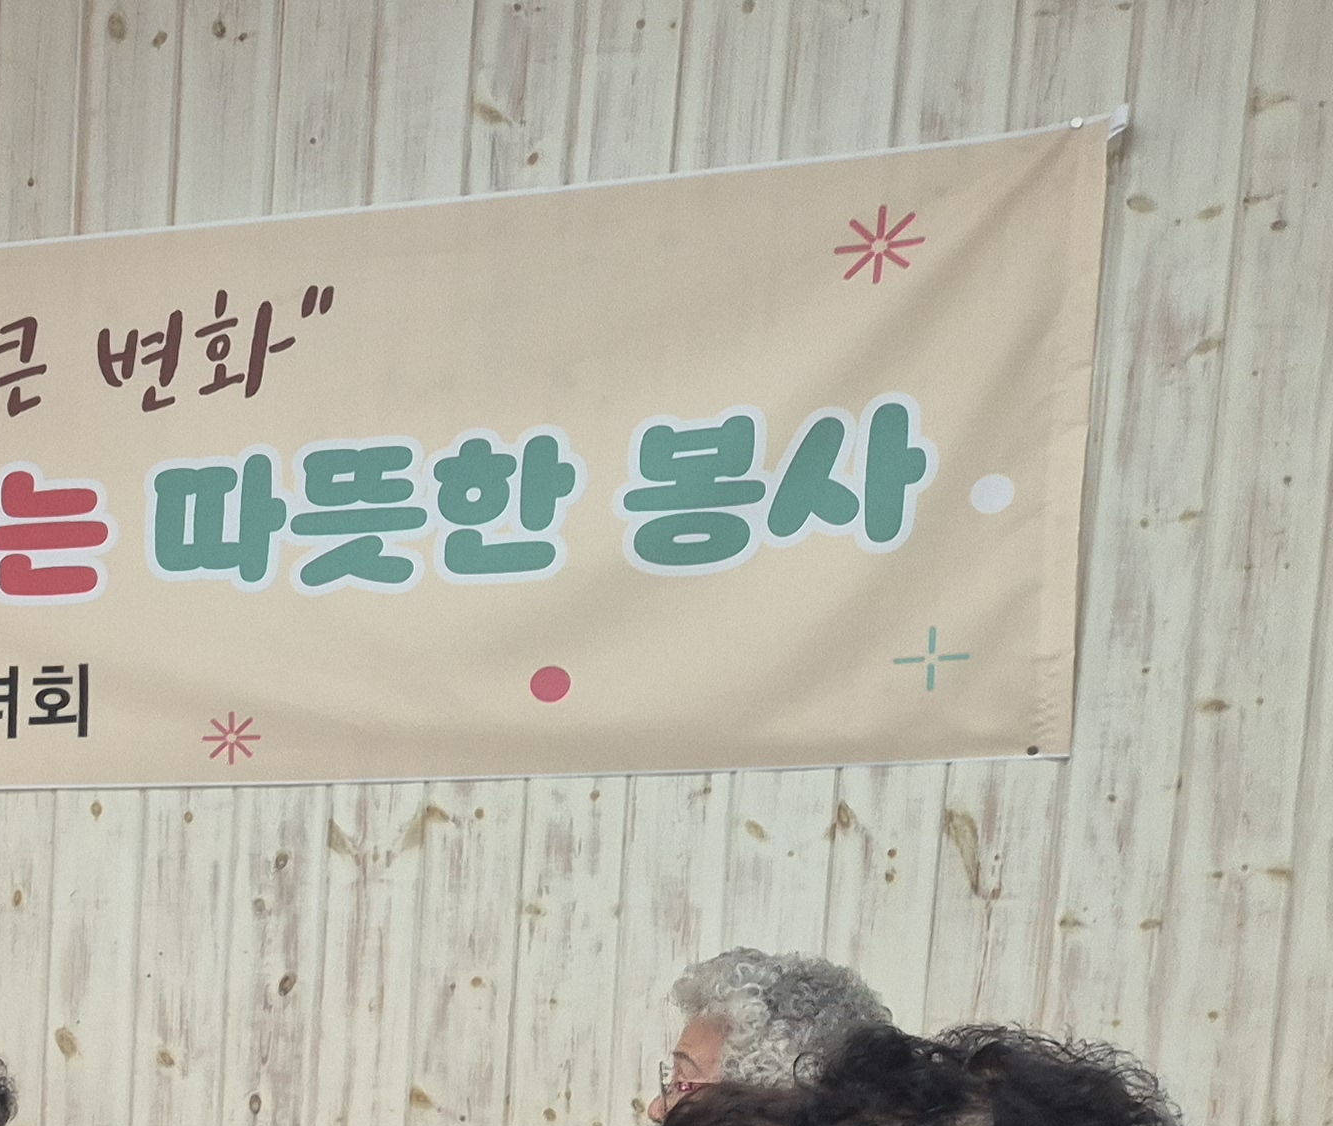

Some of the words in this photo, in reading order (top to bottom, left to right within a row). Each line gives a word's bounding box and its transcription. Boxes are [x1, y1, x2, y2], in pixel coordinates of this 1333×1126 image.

[96, 284, 336, 414] 변화"
[150, 432, 582, 590] 따뜻한
[620, 398, 933, 571] 봉사
